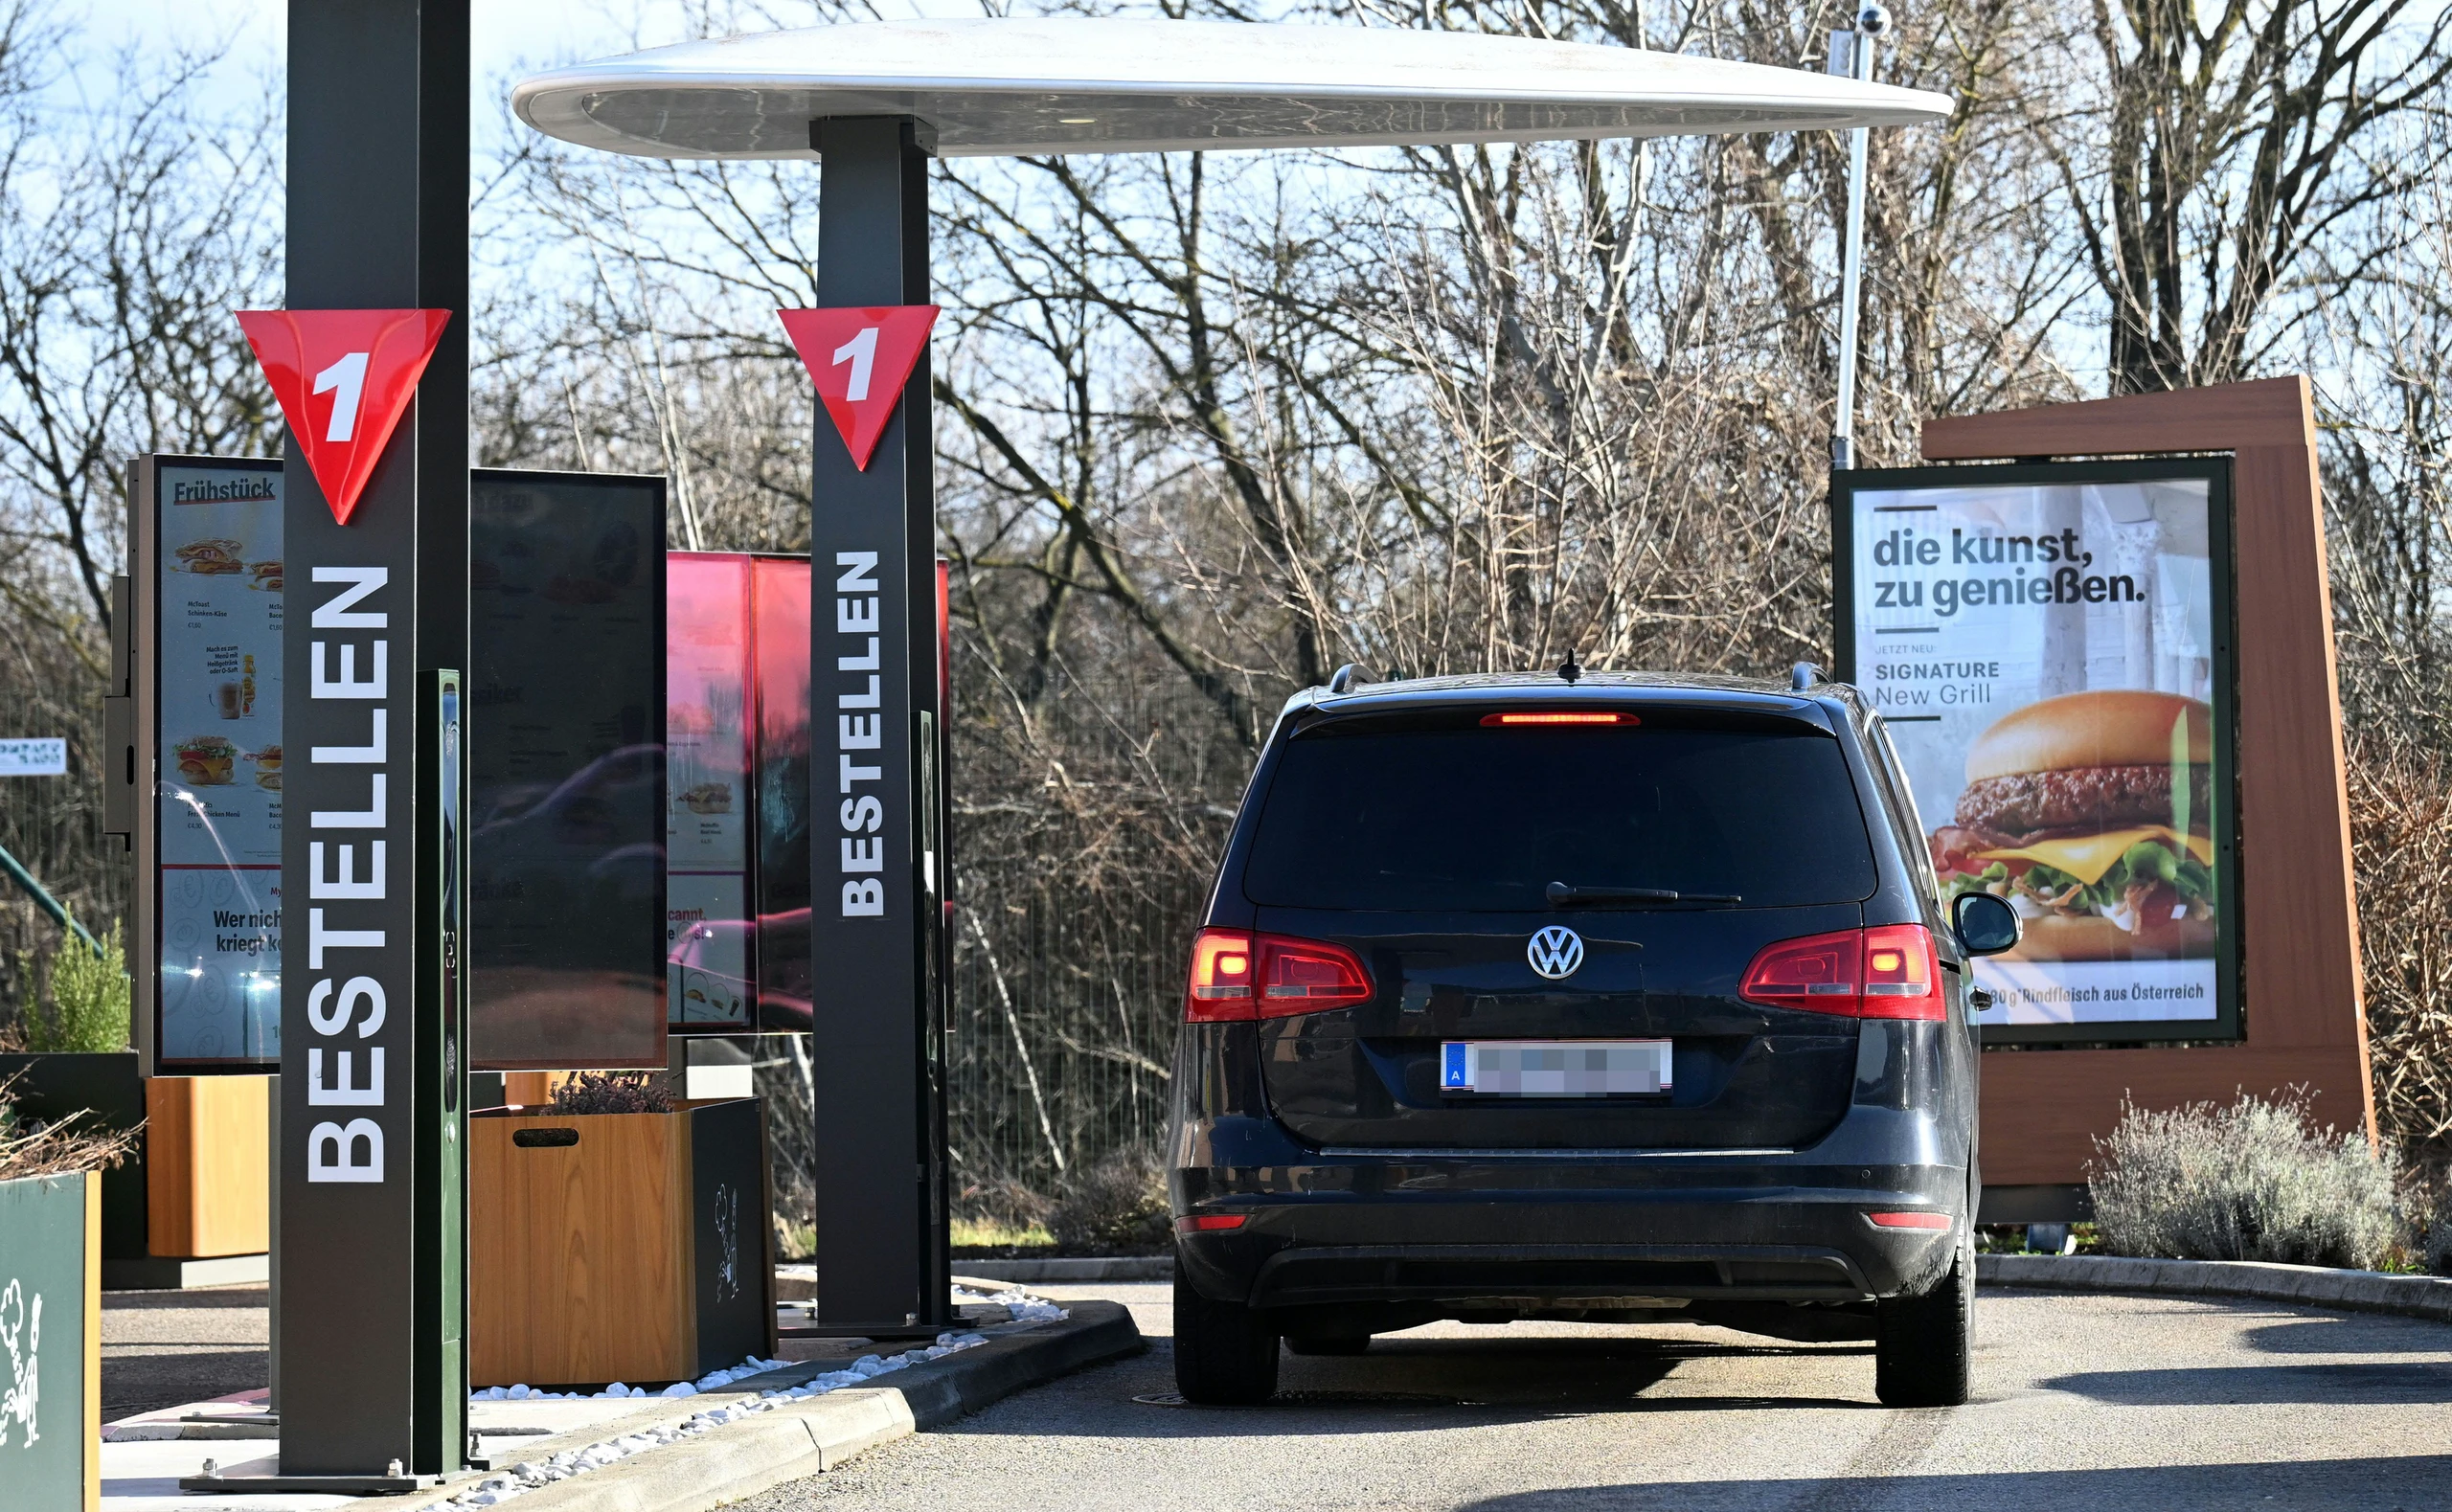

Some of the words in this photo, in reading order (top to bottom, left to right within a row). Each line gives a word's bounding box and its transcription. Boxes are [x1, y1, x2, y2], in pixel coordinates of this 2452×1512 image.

[832, 327, 879, 401] 1
[312, 352, 369, 441] 1
[174, 477, 275, 502] Frühstück
[1873, 528, 1941, 566] die
[1952, 528, 2093, 568] kunst,
[1874, 578, 1922, 608] zu
[1932, 567, 2146, 617] genießen.
[1875, 645, 1908, 654] JETZT
[1875, 662, 2000, 681] SIGNATURE
[1875, 686, 1929, 706] New
[1940, 684, 1991, 704] Grill
[836, 551, 884, 916] BESTELLEN
[307, 567, 388, 1183] BESTELLEN
[214, 910, 246, 928] Wer
[216, 934, 264, 957] kriegt
[1528, 925, 1584, 980] VW
[1986, 988, 2007, 1004] 80
[2023, 985, 2099, 1003] Rindfleisch
[2103, 988, 2127, 1002] aus
[2131, 982, 2204, 1001] Österreich
[1451, 1071, 1461, 1080] A
